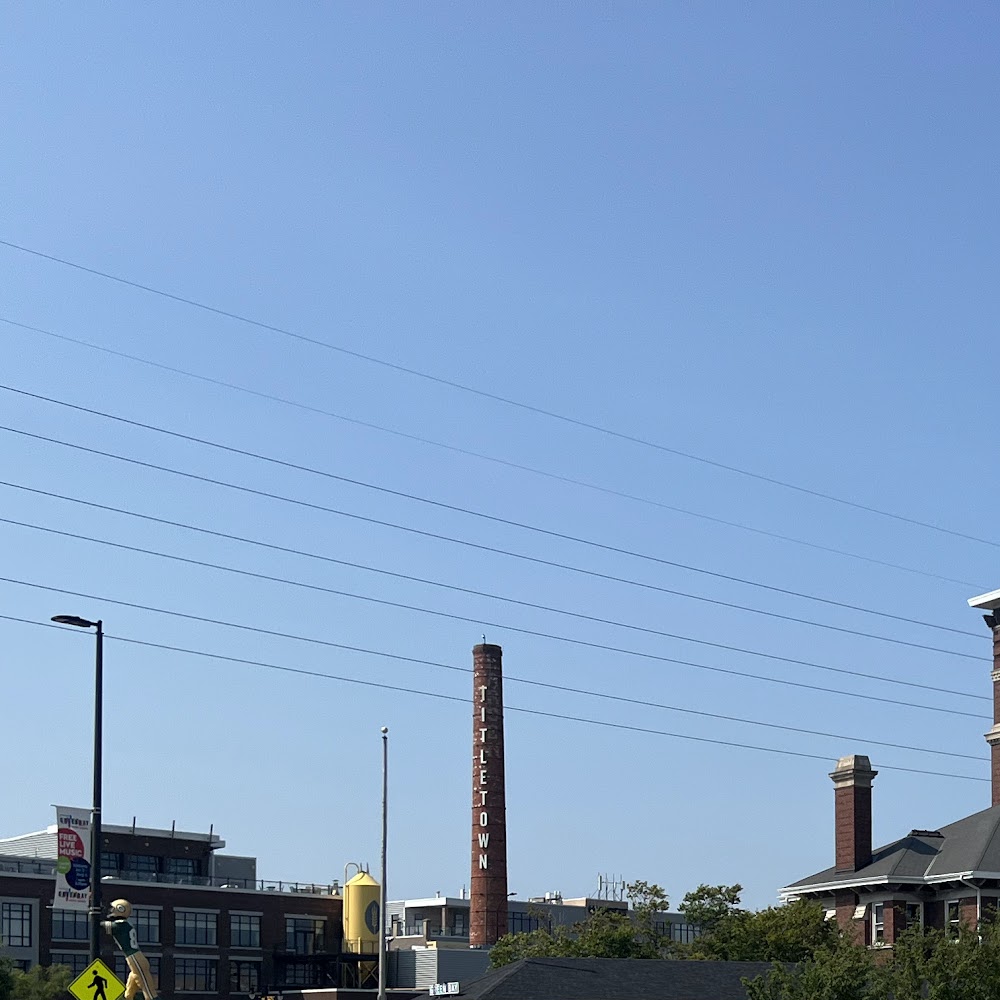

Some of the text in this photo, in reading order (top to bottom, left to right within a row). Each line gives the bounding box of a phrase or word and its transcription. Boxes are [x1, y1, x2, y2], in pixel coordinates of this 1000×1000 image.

[478, 685, 489, 869] TITLETOWN
[59, 833, 77, 841] FREE
[59, 841, 76, 849] LIVE
[59, 848, 83, 857] MUSIC
